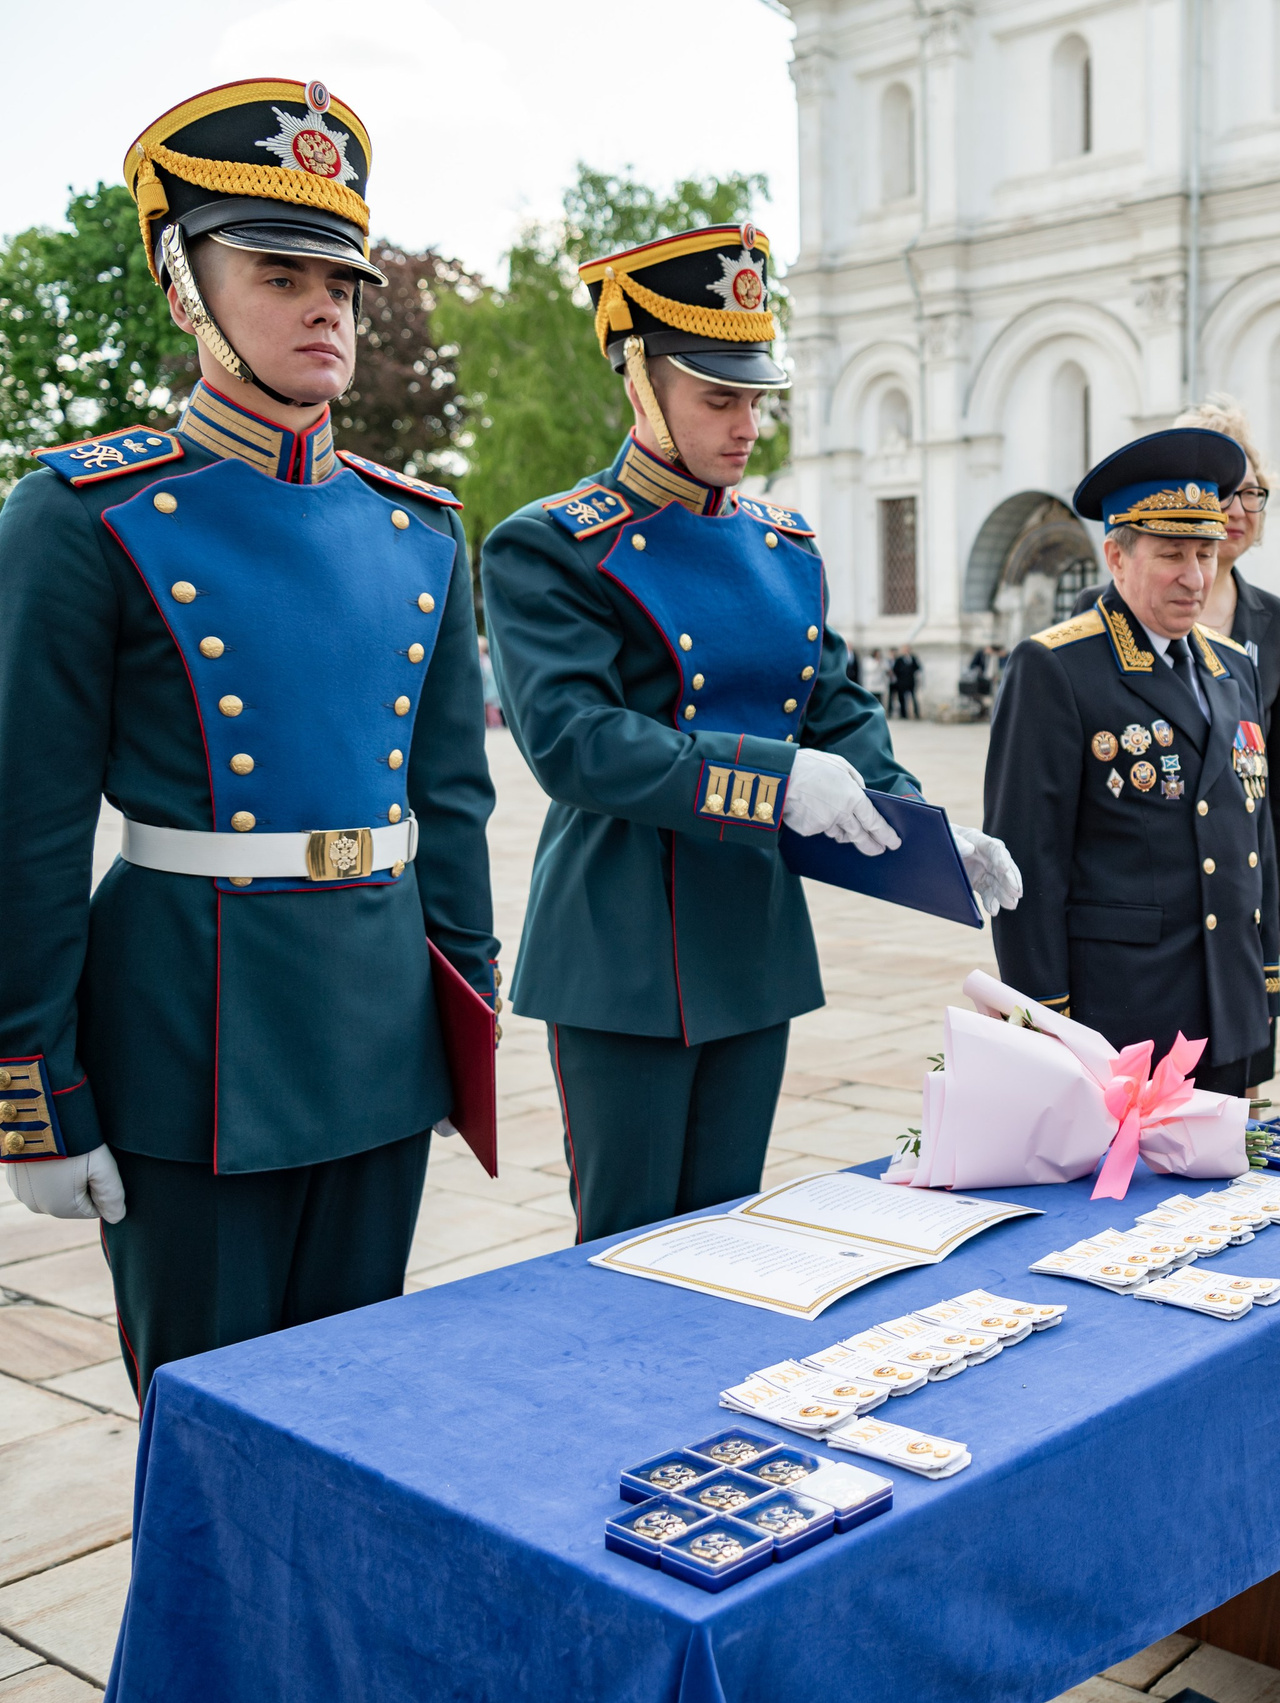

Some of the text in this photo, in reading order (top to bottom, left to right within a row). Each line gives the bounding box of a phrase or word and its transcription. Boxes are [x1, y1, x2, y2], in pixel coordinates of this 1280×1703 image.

[892, 1322, 926, 1337] КК
[858, 1336, 893, 1351] КК
[770, 1367, 808, 1384] КК
[741, 1386, 779, 1404] КК
[850, 1424, 888, 1441] КК
